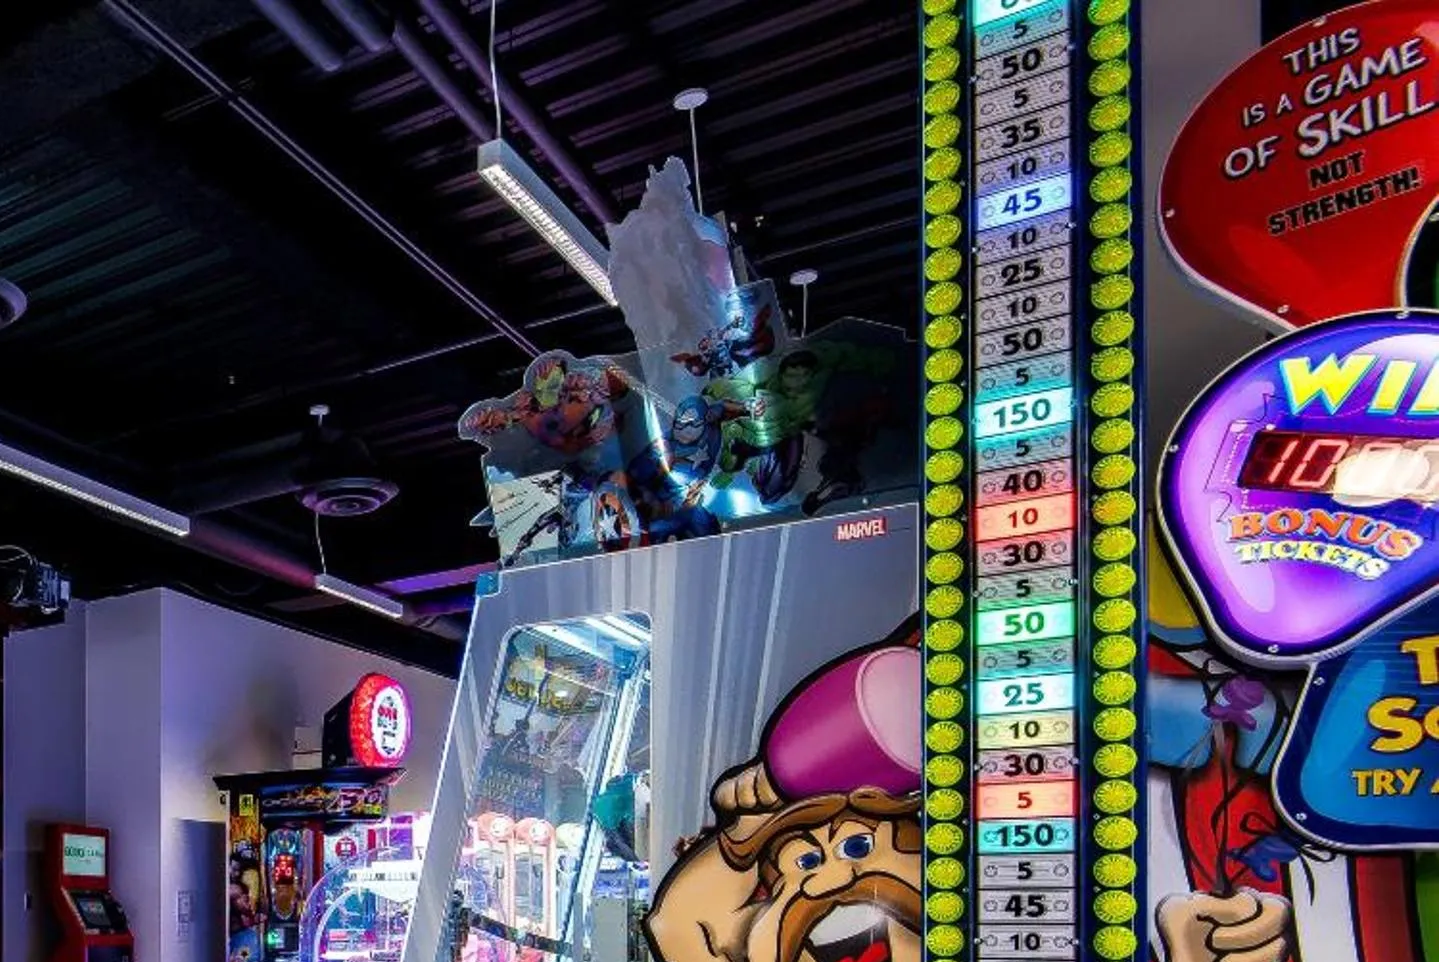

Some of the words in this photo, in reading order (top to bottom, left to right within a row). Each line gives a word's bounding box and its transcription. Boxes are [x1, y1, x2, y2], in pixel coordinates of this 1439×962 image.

[1013, 21, 1028, 39] 5
[1282, 28, 1360, 74] THIS
[1001, 49, 1041, 79] 50
[1242, 103, 1266, 127] IS
[1276, 94, 1293, 114] A
[1304, 38, 1428, 106] GAME
[1014, 89, 1029, 108] 5
[1001, 119, 1041, 148] 35
[1224, 136, 1279, 177] OF
[1298, 80, 1437, 157] SKILL
[1006, 157, 1037, 179] 10
[1310, 152, 1365, 188] NOT
[1002, 188, 1042, 215] 45
[1268, 167, 1421, 235] STRENGTH!
[1007, 228, 1037, 249] 10
[1001, 259, 1041, 287] 25
[1007, 297, 1037, 317] 10
[1001, 328, 1042, 355] 50
[1015, 368, 1030, 386] 5
[1280, 353, 1439, 416] WI
[993, 399, 1051, 428] 150
[1015, 440, 1031, 457] 5
[1002, 470, 1042, 495] 40
[836, 517, 886, 541] MARVEL
[1008, 508, 1039, 528] 10
[1227, 508, 1424, 560] BONUS
[1003, 541, 1043, 566] 30
[1235, 540, 1390, 580] TICKETS
[1016, 579, 1031, 597] 5
[1004, 612, 1045, 636] 50
[1016, 650, 1031, 668] 5
[1004, 683, 1045, 707] 25
[1010, 721, 1040, 739] 10
[1004, 753, 1045, 777] 30
[1351, 768, 1421, 796] TRY
[1017, 792, 1033, 809] 5
[997, 823, 1054, 847] 150
[1017, 862, 1033, 880] 5
[1005, 894, 1046, 917] 45
[1010, 933, 1041, 950] 10
